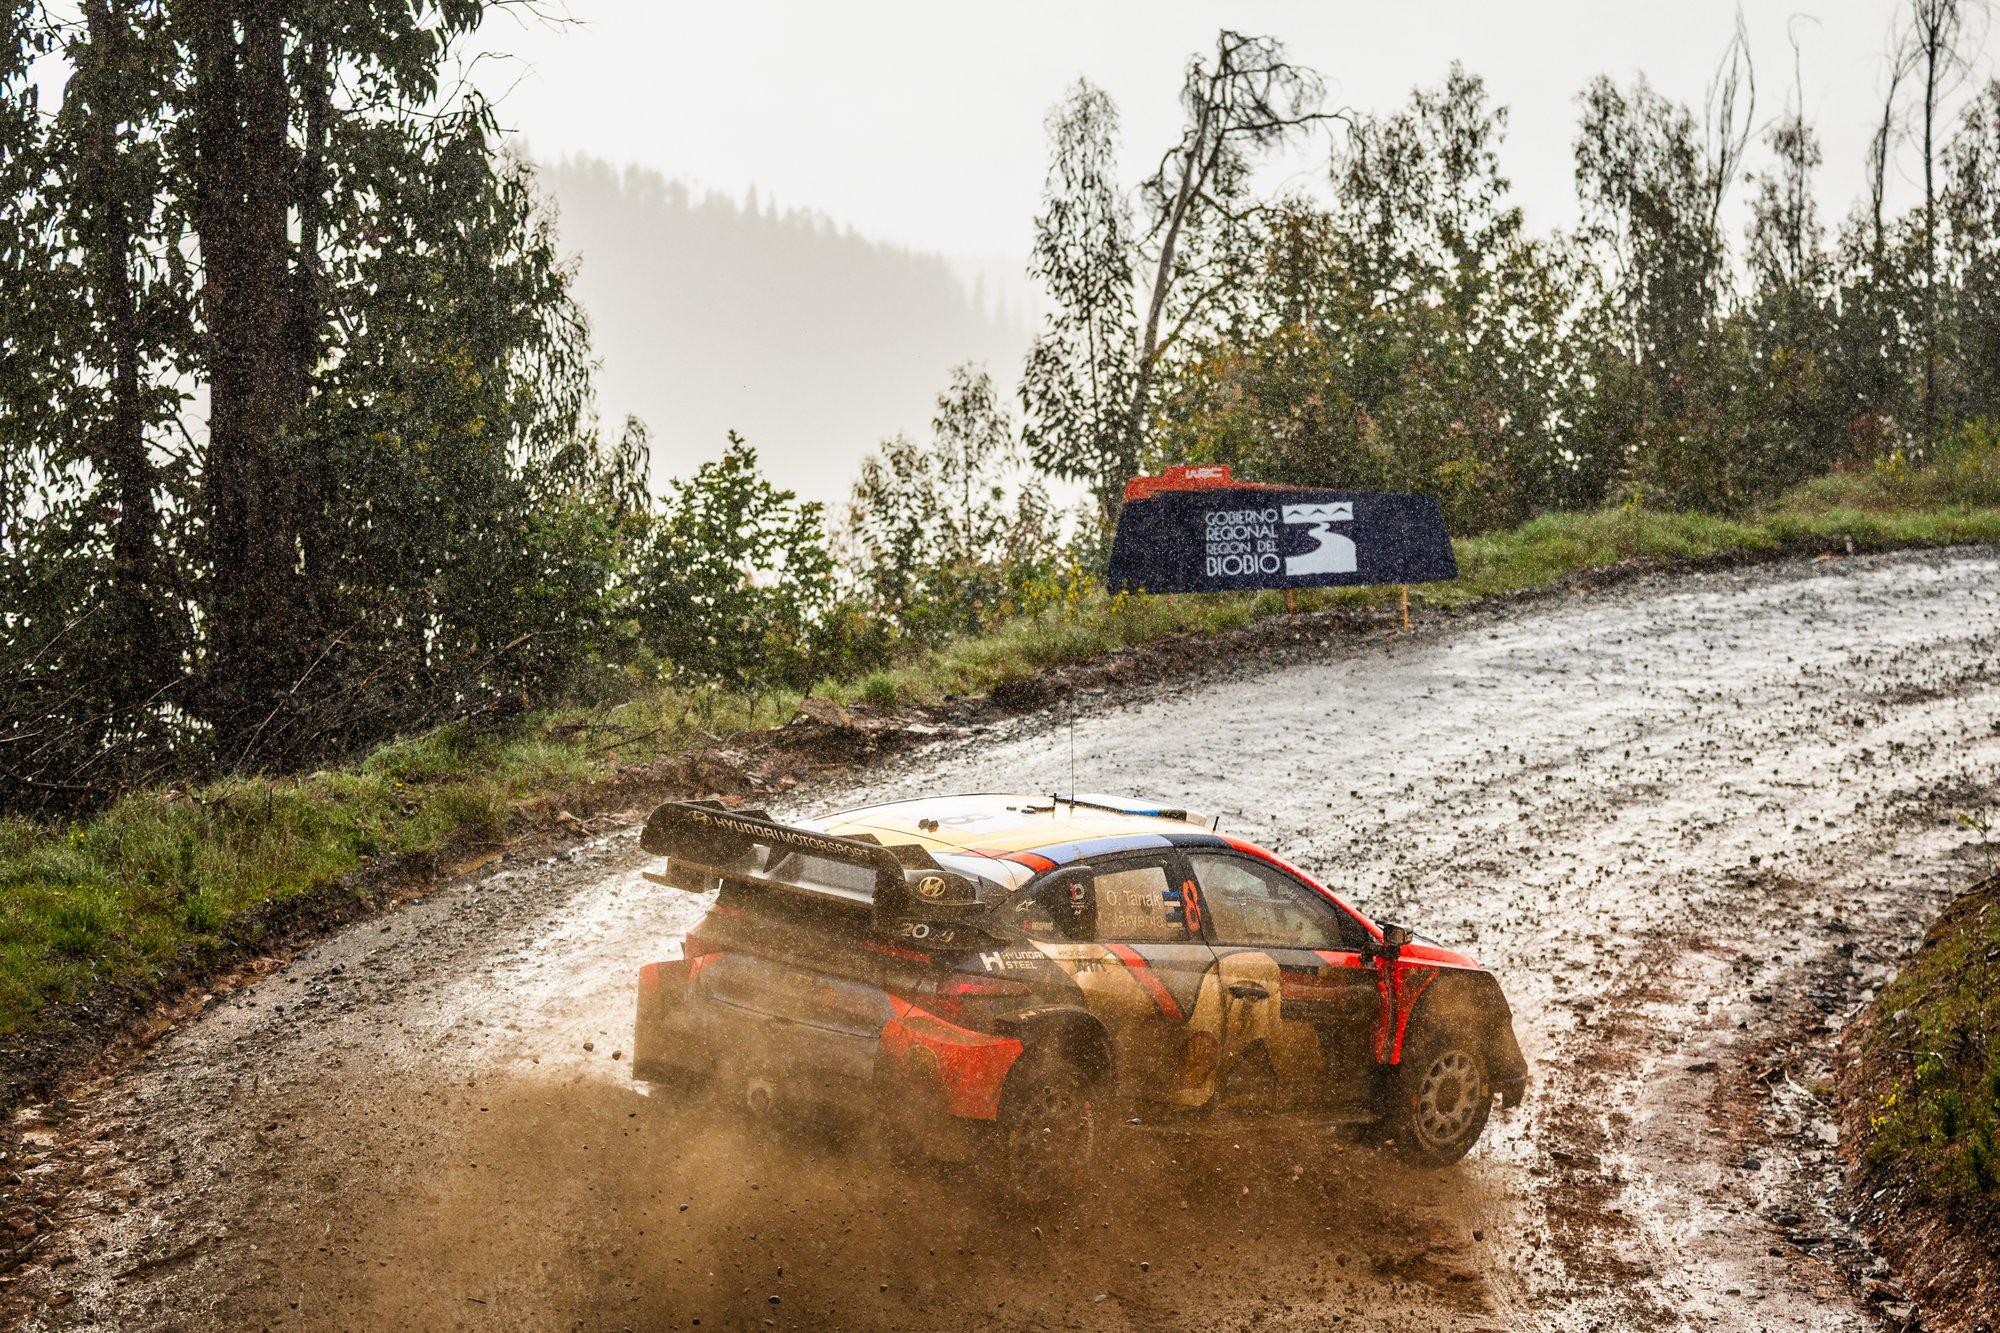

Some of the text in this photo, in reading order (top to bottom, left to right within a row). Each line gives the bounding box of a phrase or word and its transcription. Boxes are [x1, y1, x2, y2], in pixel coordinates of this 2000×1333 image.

[1205, 510, 1278, 526] GOBIERNO
[1206, 524, 1278, 541] REGIONAL
[1257, 540, 1279, 553] DEL
[714, 817, 870, 858] HYUNDAI MOTORSPORT
[1183, 880, 1201, 932] 8
[1001, 950, 1045, 960] HYUNDAI
[1004, 960, 1038, 970] STEEL
